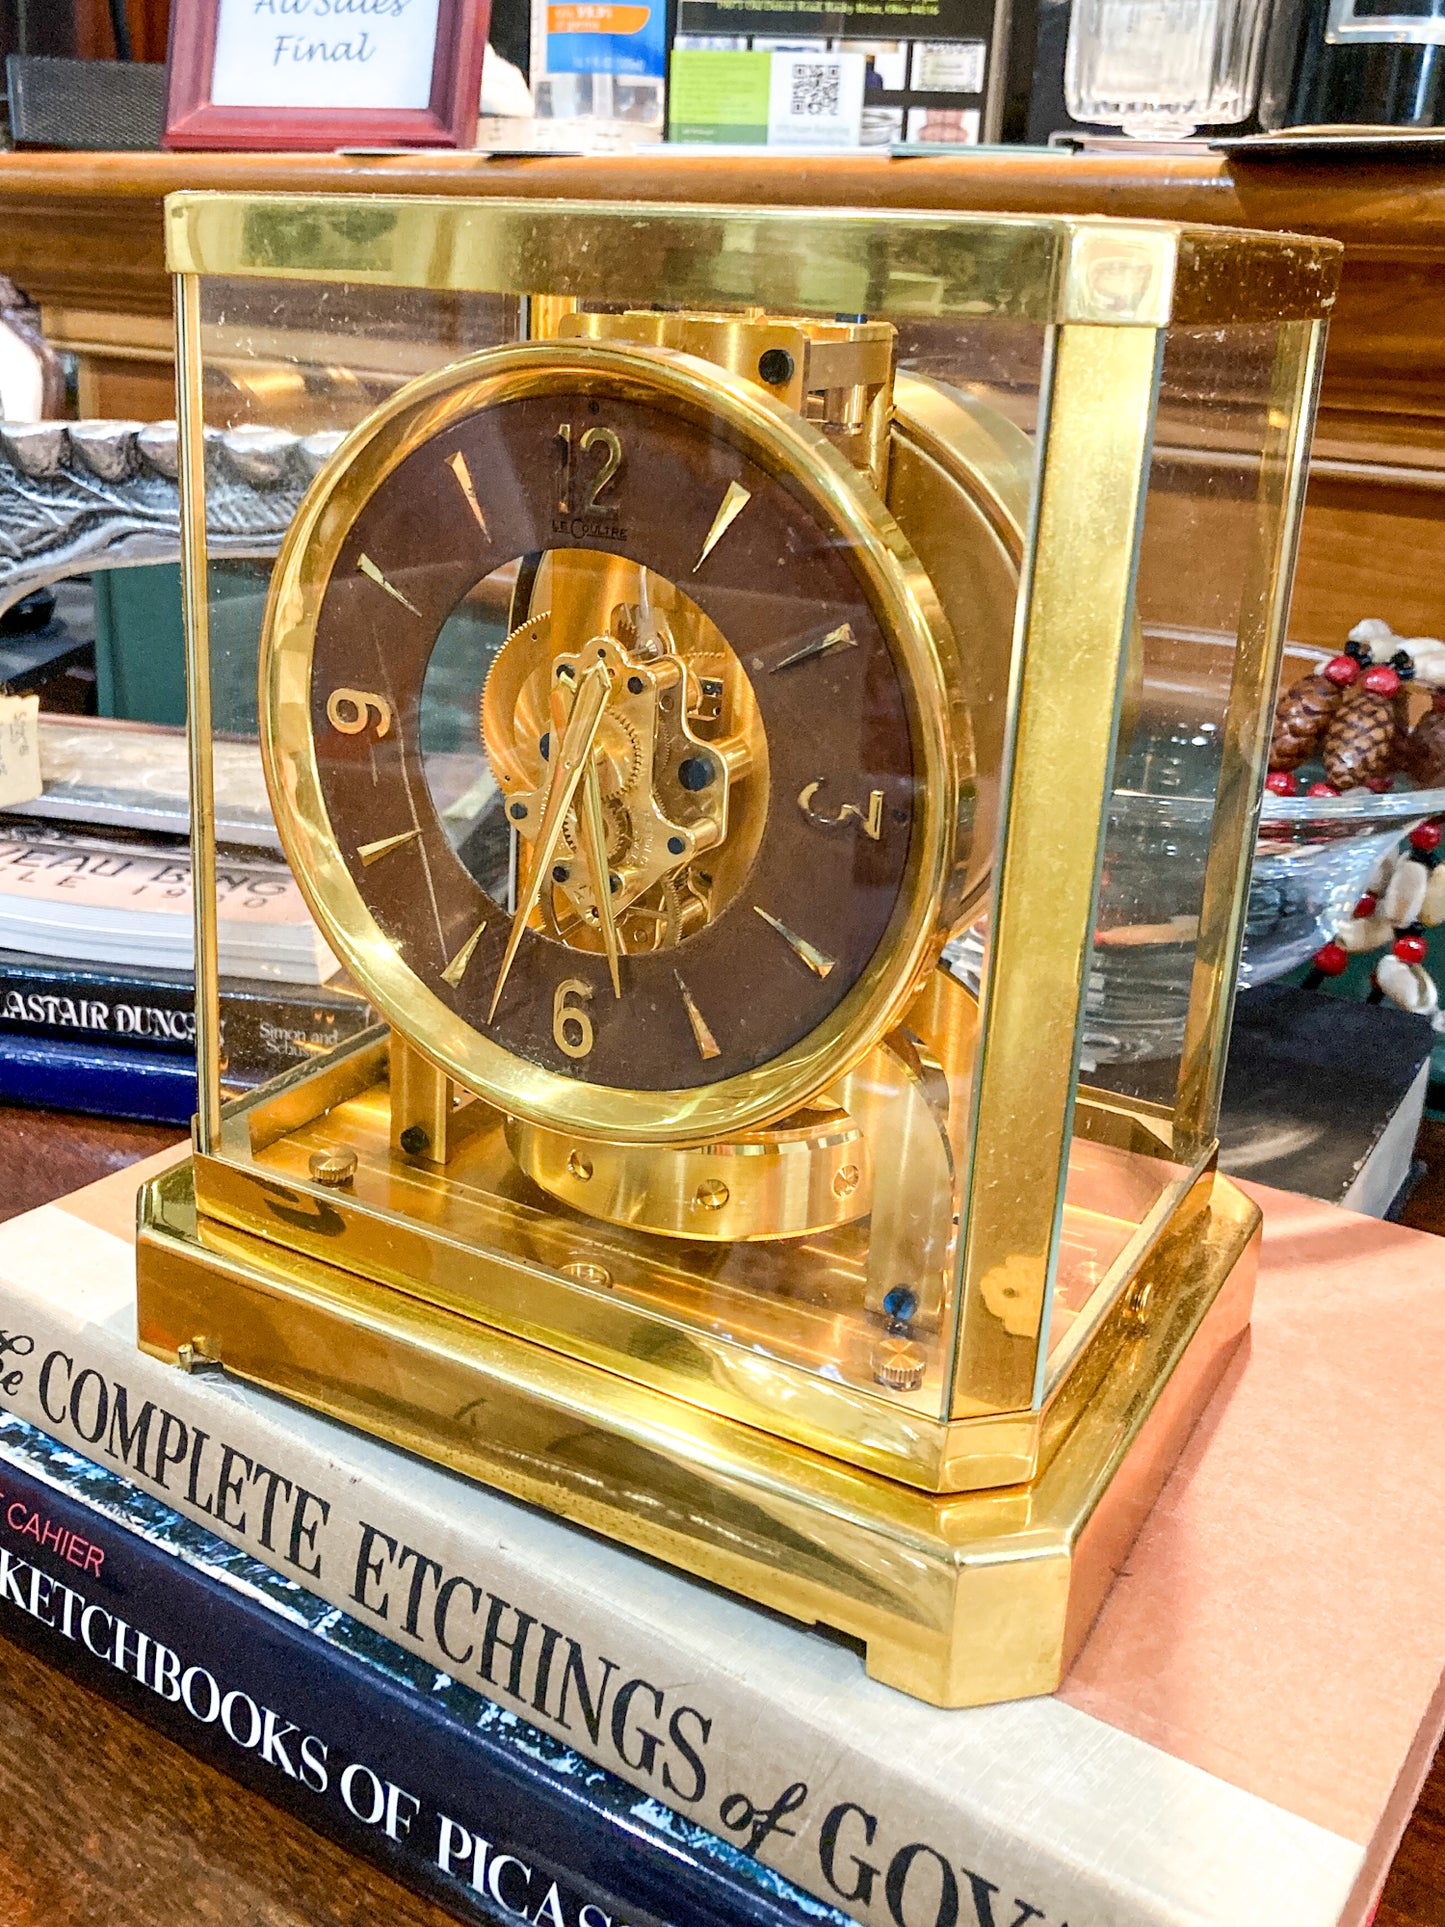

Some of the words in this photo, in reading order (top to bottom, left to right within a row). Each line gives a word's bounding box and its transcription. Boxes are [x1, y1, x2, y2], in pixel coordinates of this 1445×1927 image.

[273, 31, 376, 66] Final
[552, 424, 622, 513] 12
[326, 687, 391, 738] 9
[150, 864, 287, 897] BNG
[113, 1003, 226, 1047] DUNC
[260, 1021, 307, 1043] Simon
[310, 1028, 339, 1047] and
[553, 979, 593, 1058] 6
[7, 1502, 105, 1579] CAHIER
[38, 1350, 331, 1580] COMPLETE
[348, 1520, 712, 1804] ETCHINGS
[719, 1782, 808, 1857] of
[819, 1802, 1070, 1927] GOY
[340, 1763, 421, 1843] OF
